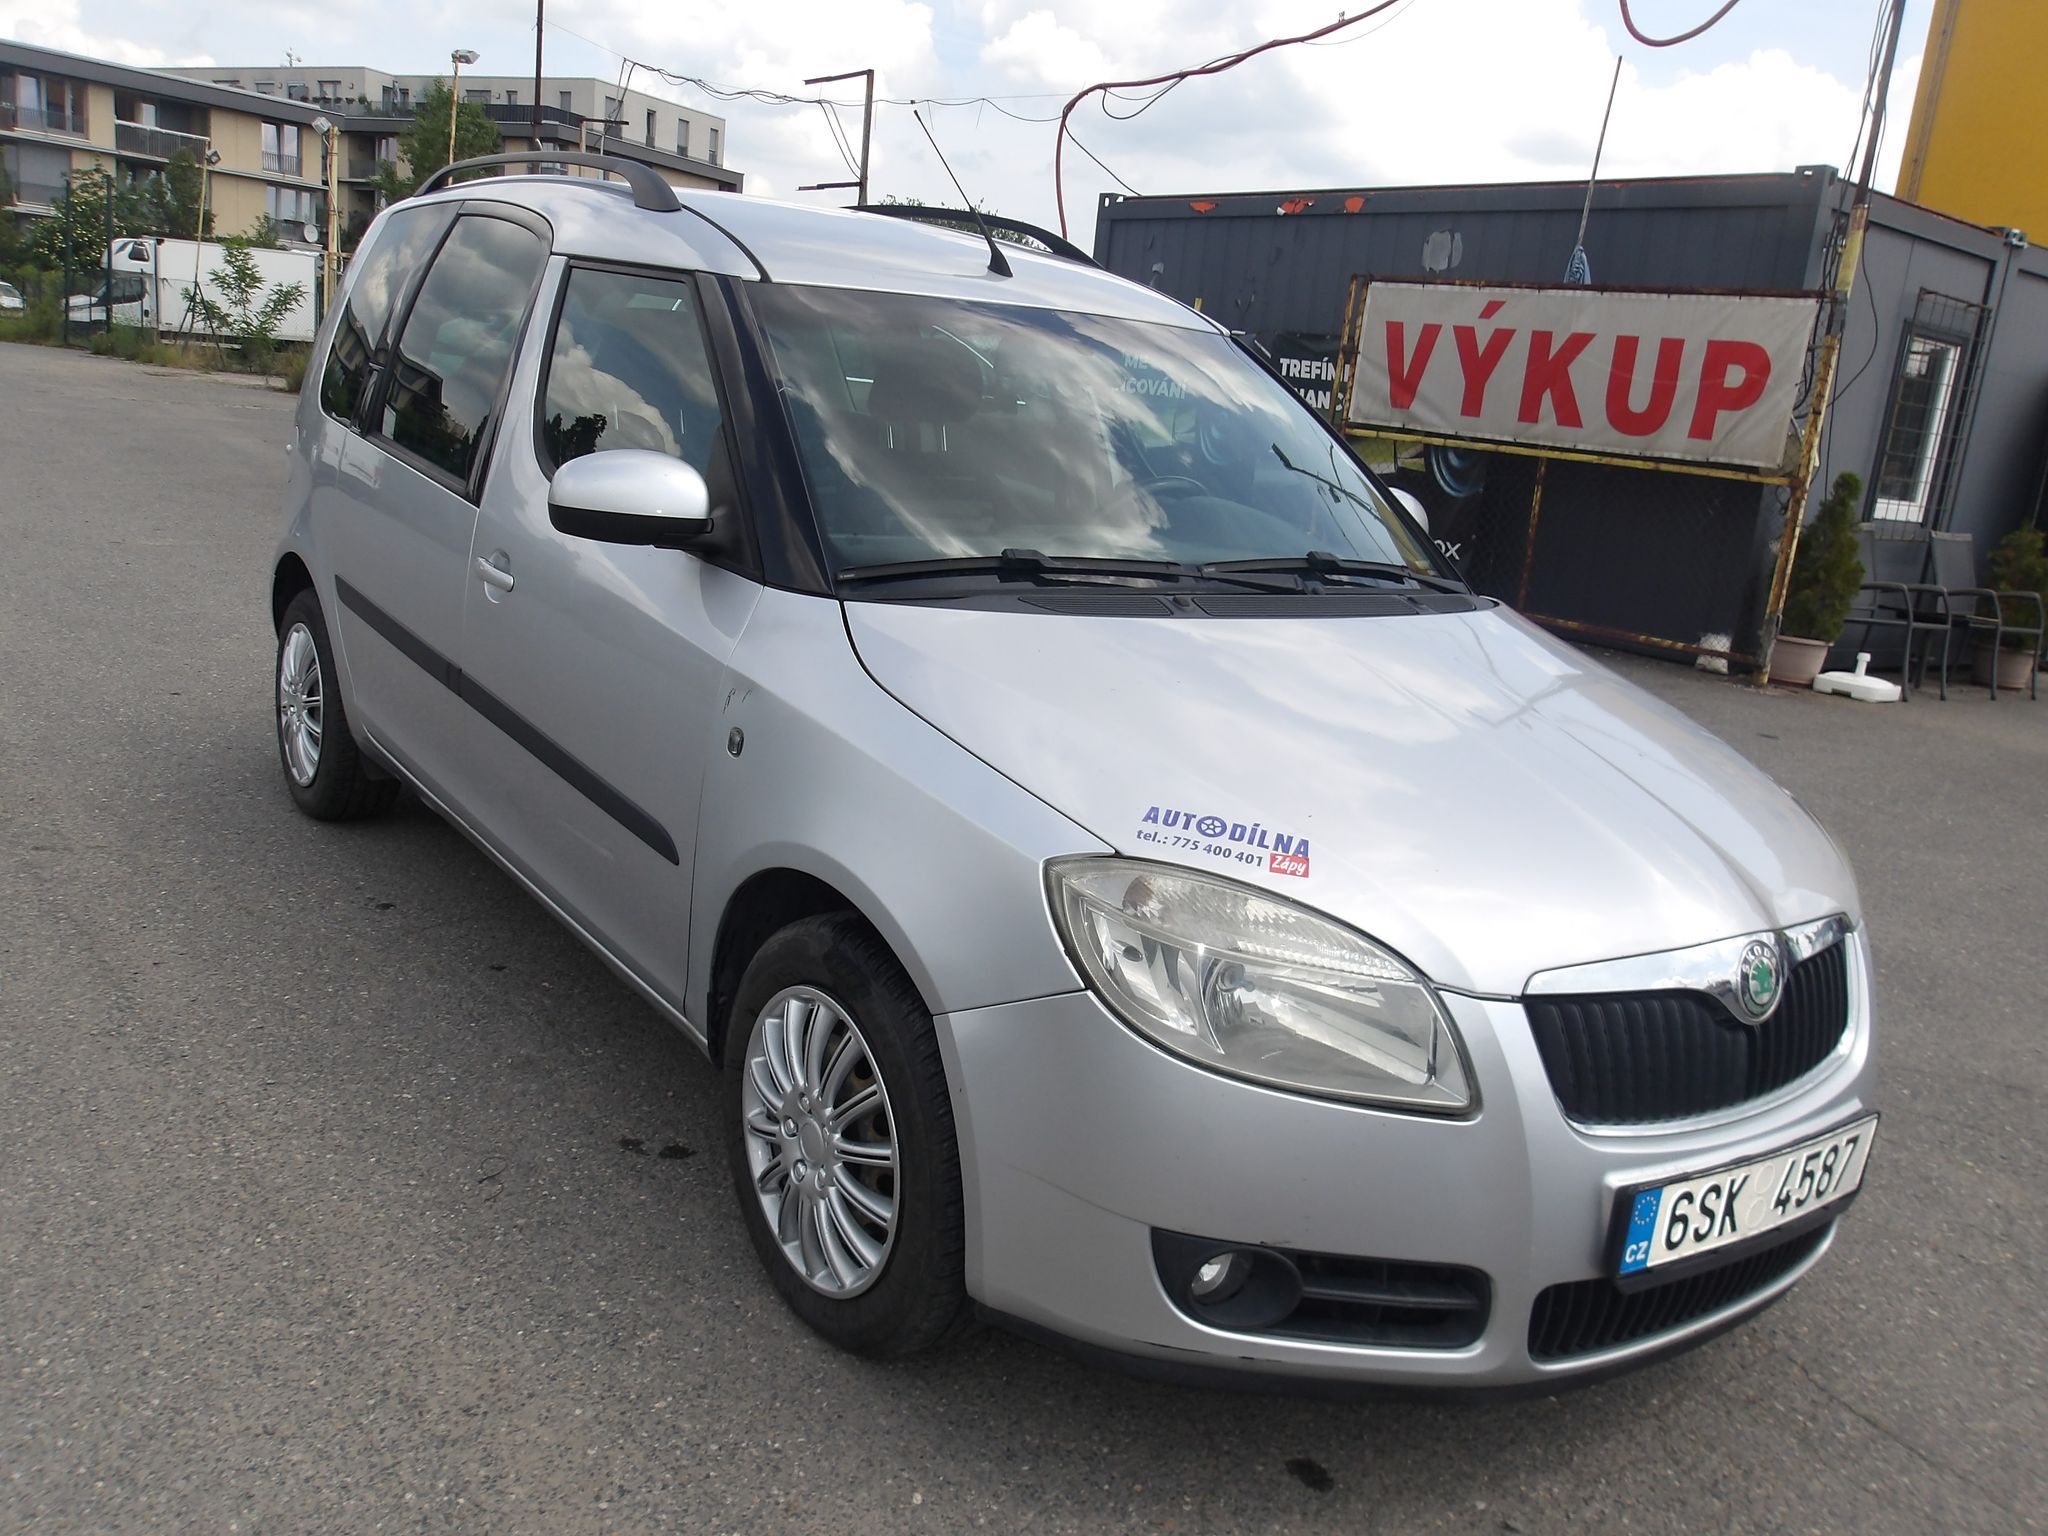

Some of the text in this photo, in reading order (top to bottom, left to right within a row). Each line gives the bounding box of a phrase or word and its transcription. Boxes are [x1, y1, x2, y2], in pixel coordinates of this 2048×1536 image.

[1385, 300, 1772, 441] VÝKUP
[1136, 829, 1263, 867] tel.: 775 400 401
[1271, 855, 1307, 875] Zápy
[1664, 1134, 1860, 1251] 6SK 4587
[1625, 1240, 1649, 1264] CZ
